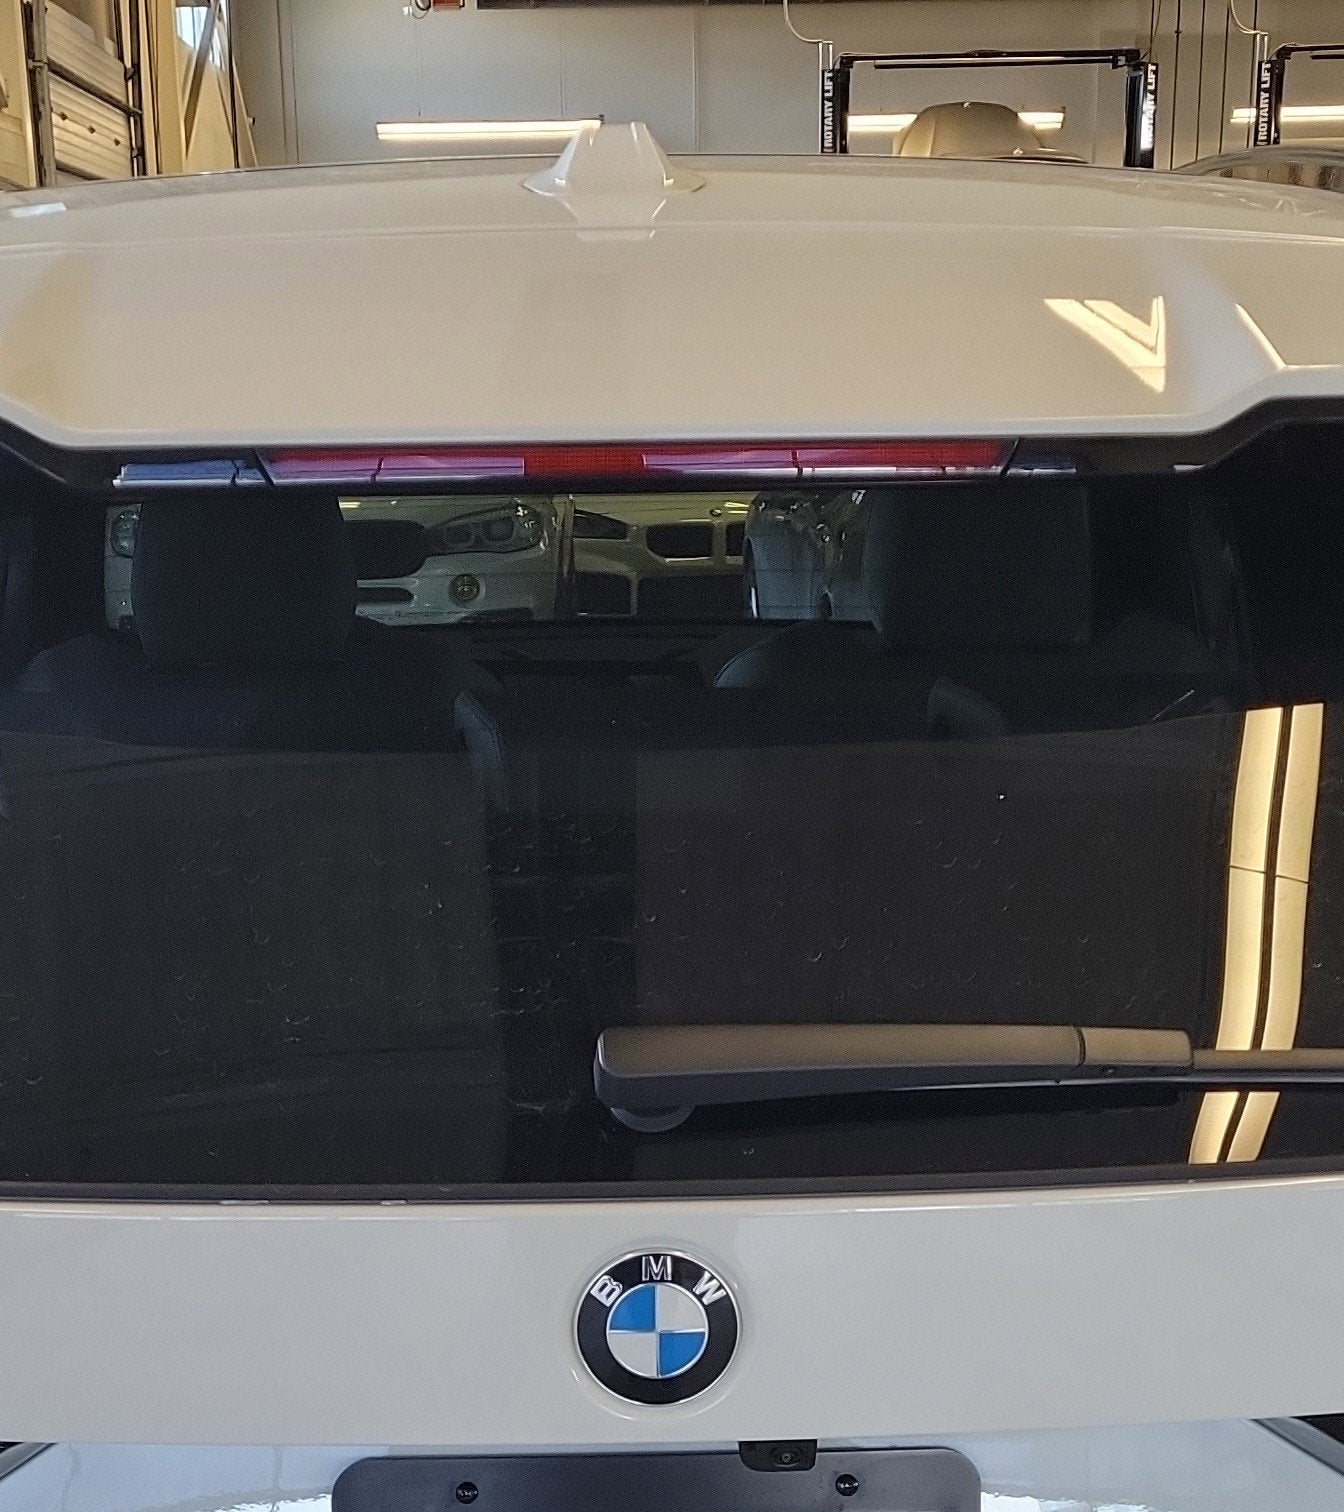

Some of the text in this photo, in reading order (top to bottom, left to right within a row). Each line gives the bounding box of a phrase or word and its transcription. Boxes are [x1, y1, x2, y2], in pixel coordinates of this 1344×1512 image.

[824, 70, 833, 147] ROTARY LIFT
[1258, 61, 1272, 140] ROTARY LIFT
[589, 1255, 727, 1308] BMW
